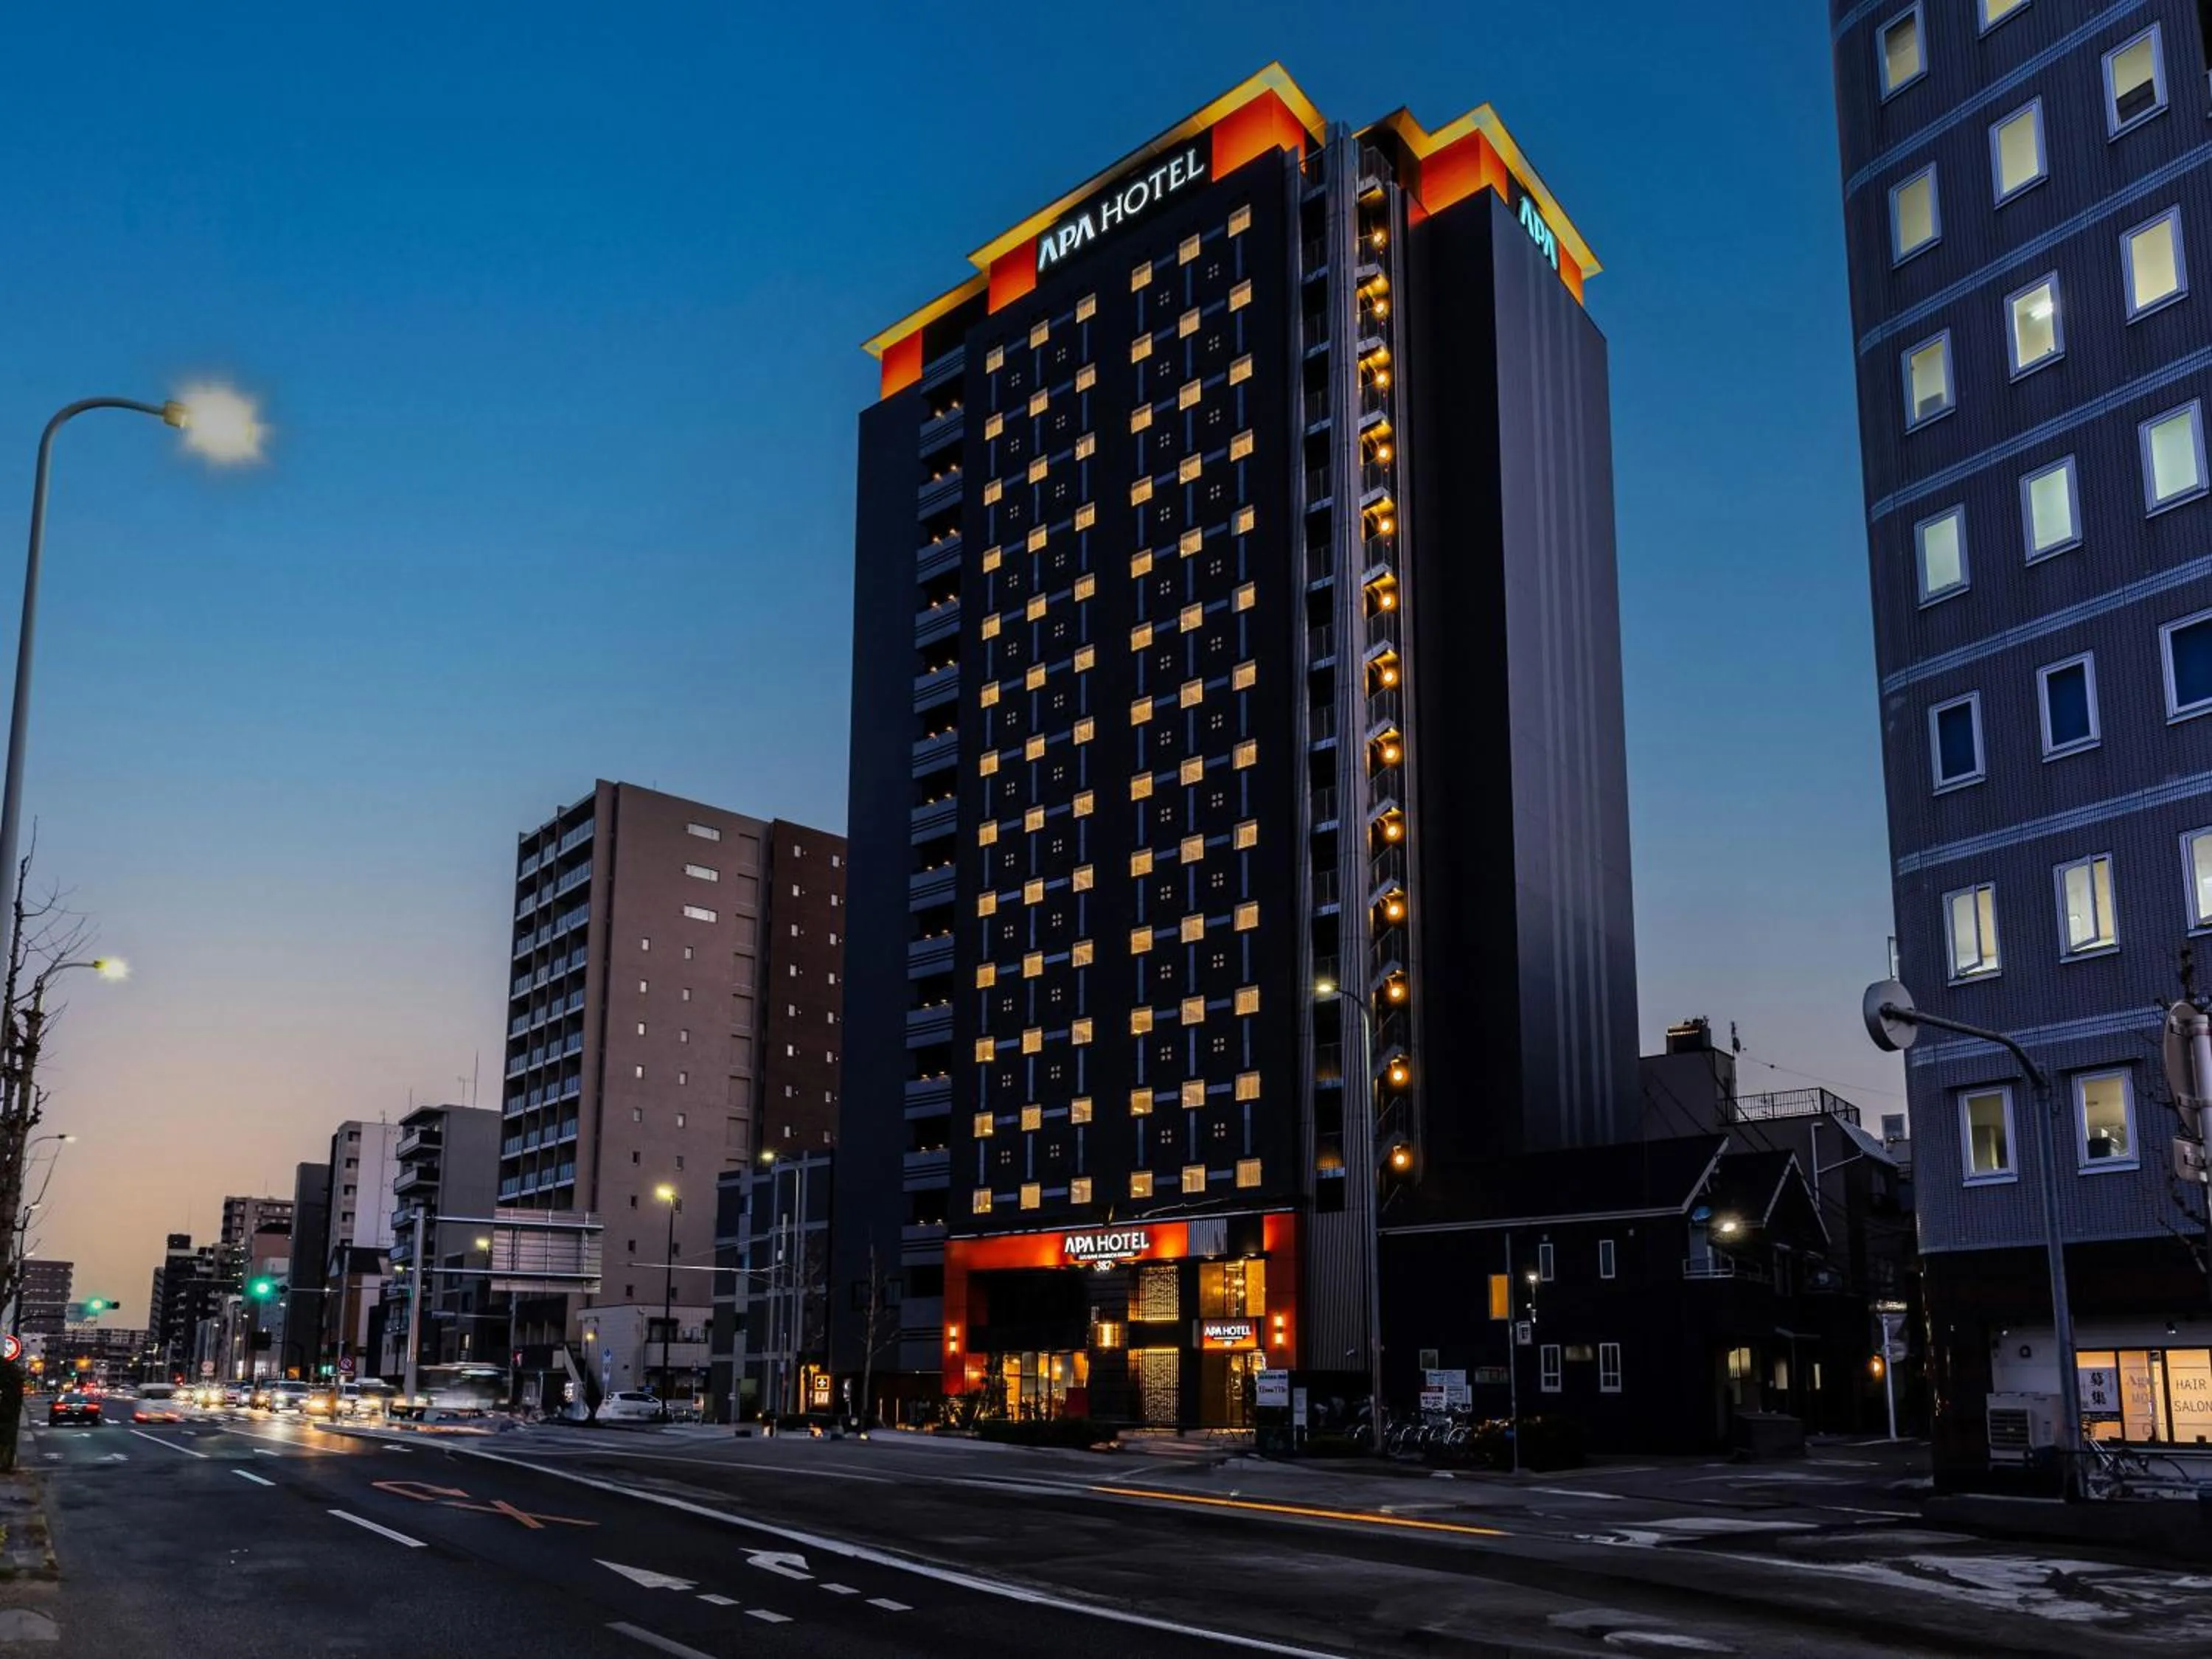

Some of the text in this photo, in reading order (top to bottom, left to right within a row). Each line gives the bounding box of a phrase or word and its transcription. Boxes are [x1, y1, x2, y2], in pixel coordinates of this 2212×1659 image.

[1037, 148, 1205, 272] APA HOTEL
[1520, 196, 1557, 270] APA
[1064, 1232, 1150, 1253] APA HOTEL
[1204, 1325, 1251, 1336] APA HOTEL
[2176, 1378, 2207, 1390] HAIR
[2174, 1400, 2212, 1412] SALON
